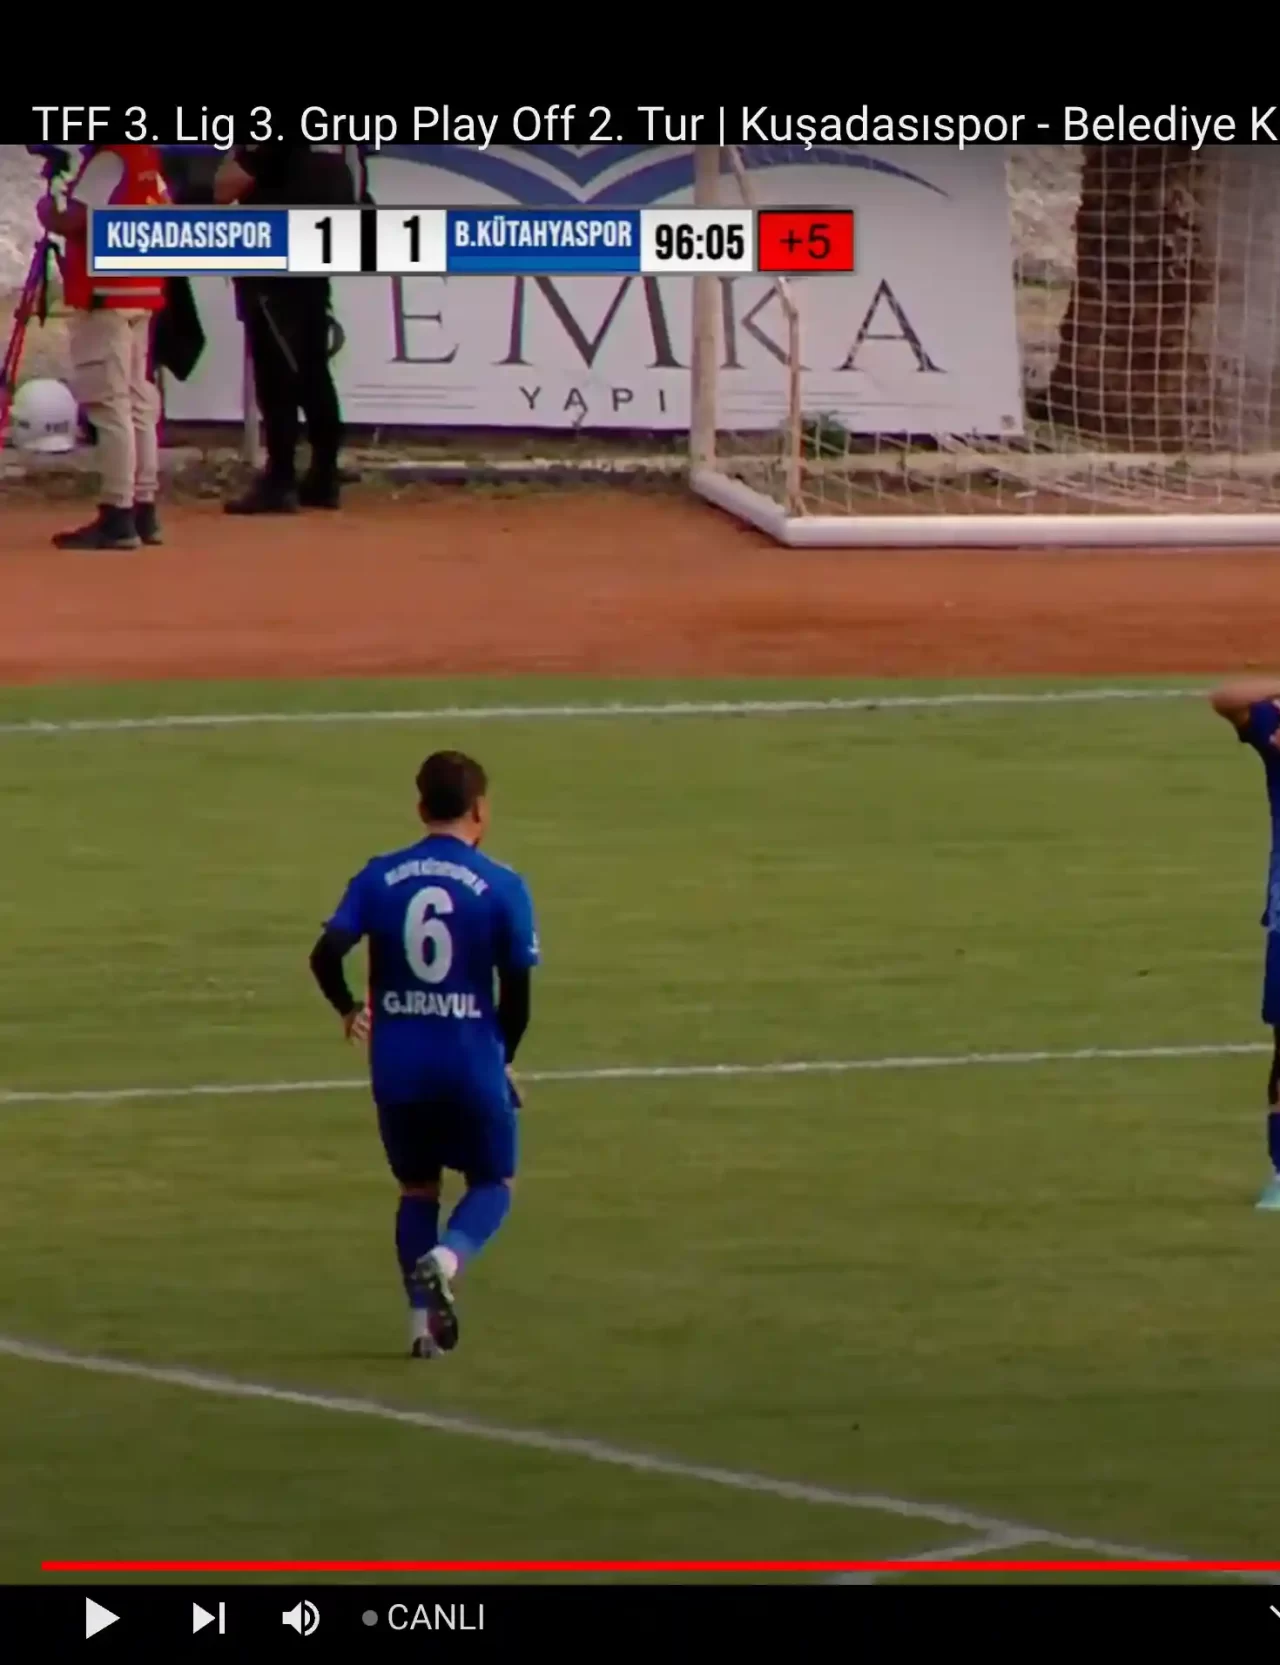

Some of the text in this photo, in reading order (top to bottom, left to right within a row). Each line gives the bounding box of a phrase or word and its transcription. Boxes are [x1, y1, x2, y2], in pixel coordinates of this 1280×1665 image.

[326, 276, 948, 373] EMKA
[519, 386, 667, 413] YAPI
[404, 885, 454, 985] 6
